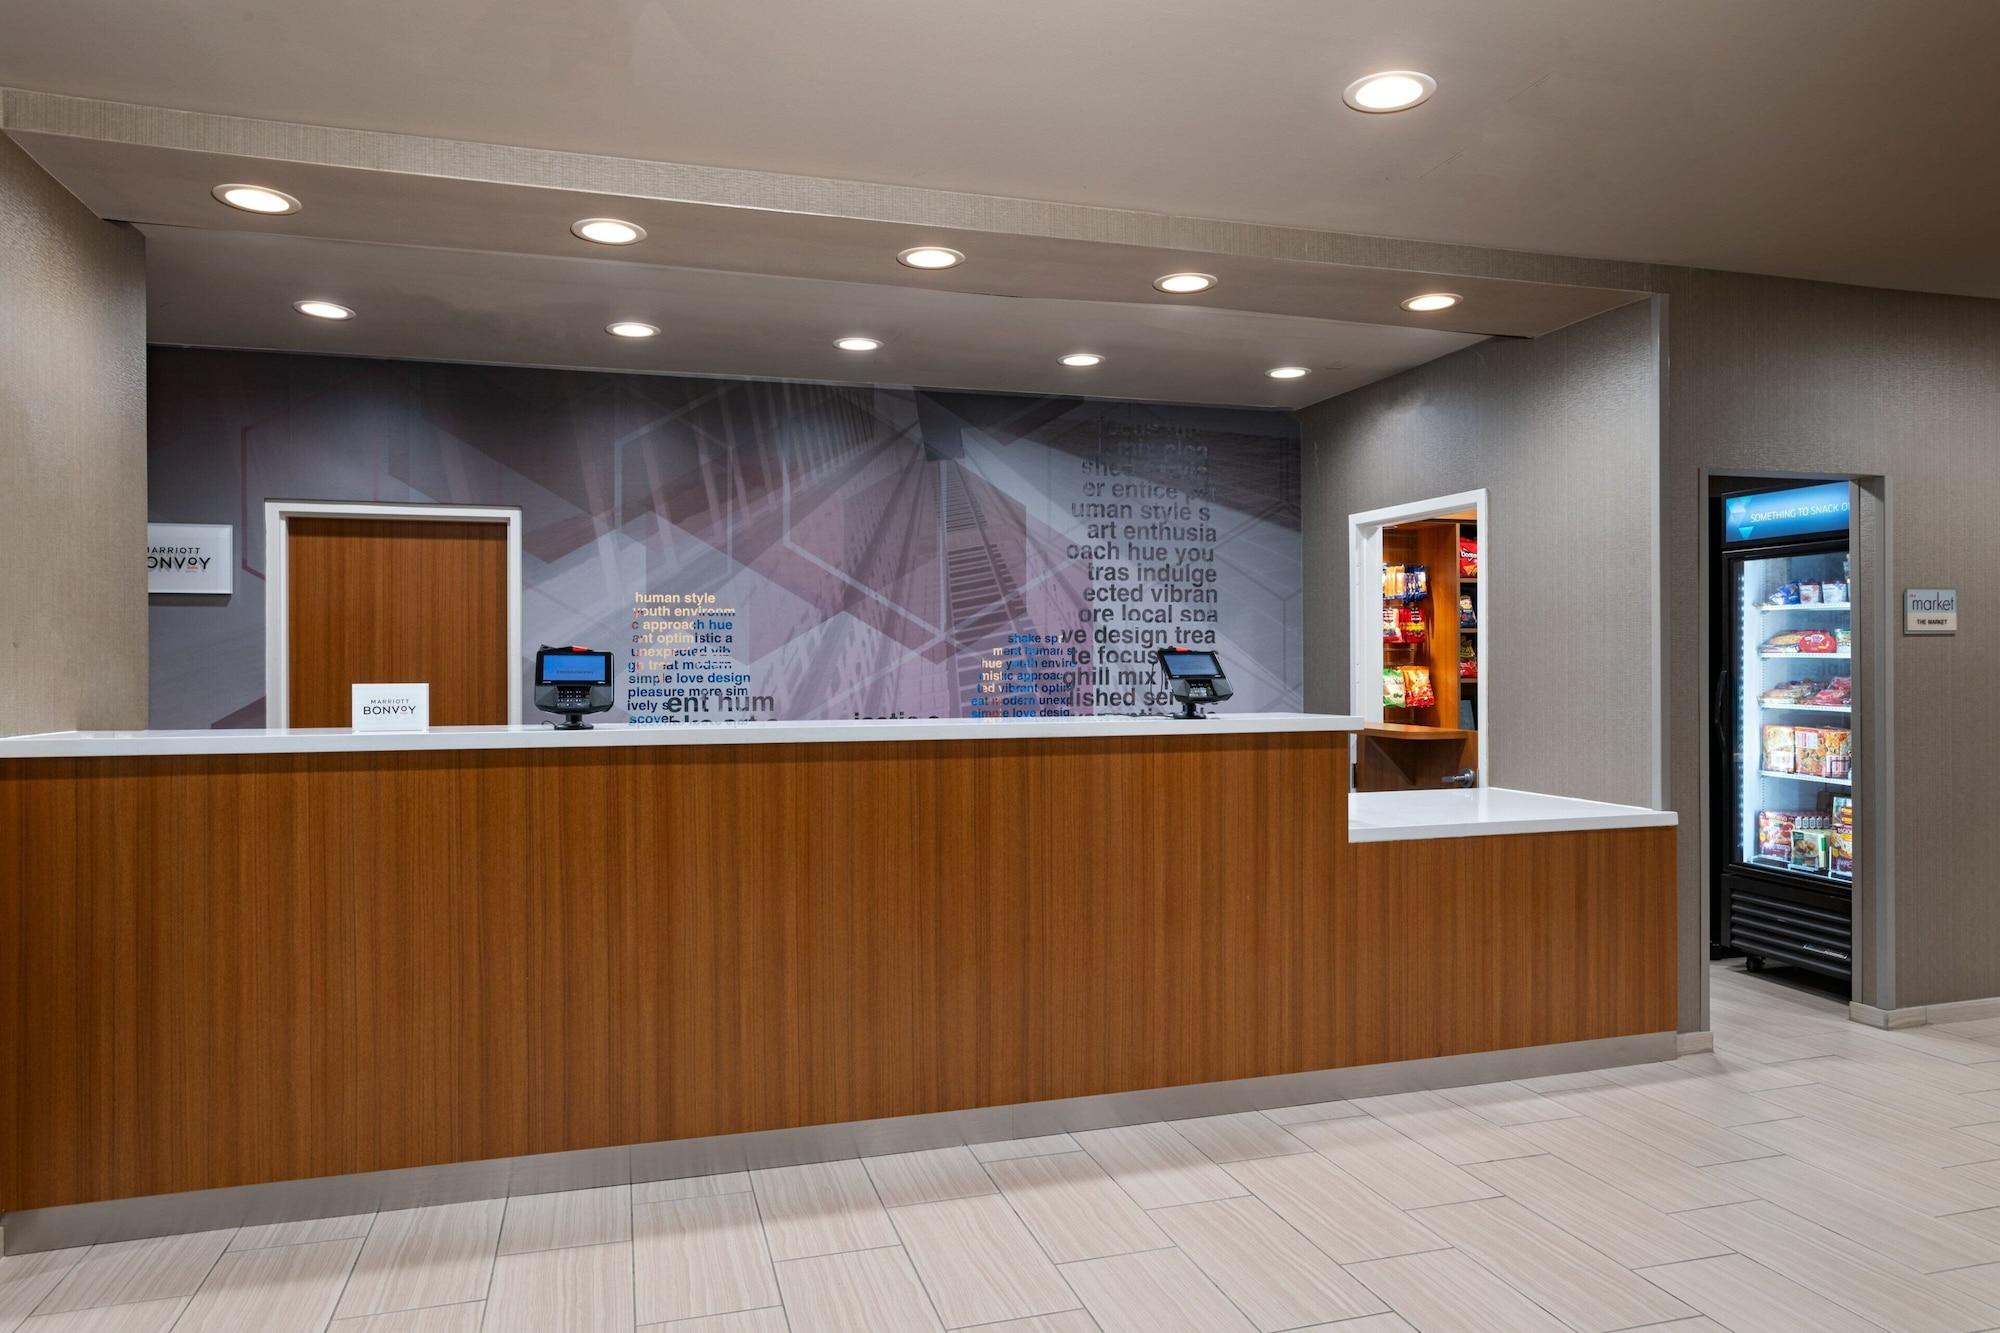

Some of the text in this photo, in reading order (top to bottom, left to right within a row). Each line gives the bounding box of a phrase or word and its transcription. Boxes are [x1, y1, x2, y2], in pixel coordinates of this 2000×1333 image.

[1112, 482, 1177, 499] entice
[1071, 503, 1210, 525] uman style s
[1750, 509, 1797, 523] SOMETHING
[1798, 507, 1810, 517] TO
[1811, 504, 1839, 516] SNACK
[1087, 522, 1217, 542] art enthusia
[1128, 543, 1168, 561] hue
[1175, 547, 1214, 565] you
[1087, 564, 1217, 587] tras indulge
[635, 592, 716, 606] human style
[1083, 584, 1218, 603] ected vibran
[1912, 592, 1954, 611] market
[632, 606, 670, 619] youth
[1078, 608, 1115, 623] ore
[1122, 604, 1172, 623] local
[643, 620, 704, 633] approach
[709, 620, 733, 630] hue
[657, 633, 723, 647] optimistic
[725, 634, 733, 643] a
[1008, 633, 1041, 643] shake
[1062, 626, 1216, 648] ve design trea
[993, 646, 1022, 656] ment
[1072, 646, 1159, 664] te focus
[982, 658, 1002, 668] hue
[676, 673, 703, 683] love
[708, 673, 751, 686] design
[628, 686, 748, 700] pleasure more sim
[999, 682, 1038, 693] vibrant
[669, 693, 774, 712] ent hum
[971, 696, 988, 705] eat
[1070, 688, 1136, 706] lished
[363, 705, 416, 715] BONVOY
[627, 700, 657, 713] ively
[1013, 707, 1036, 718] love
